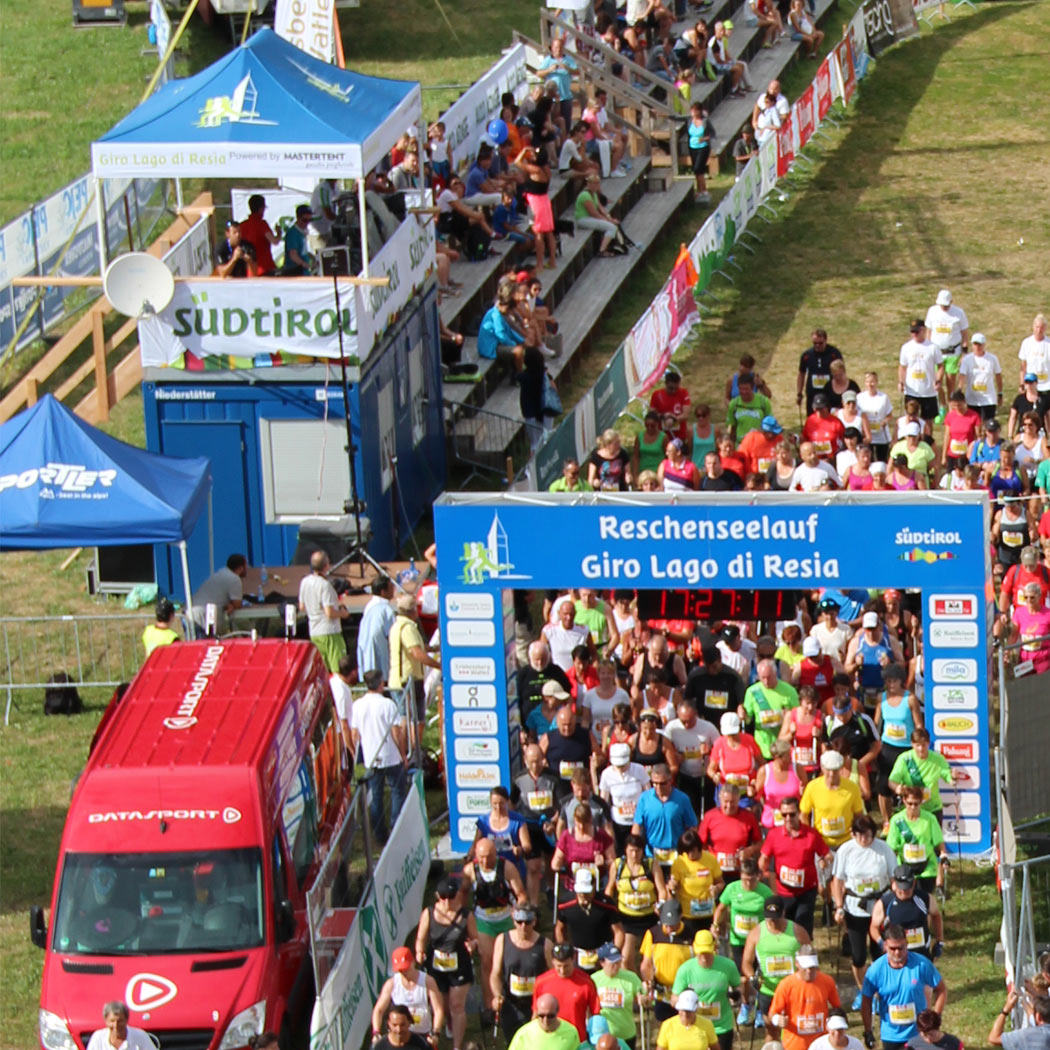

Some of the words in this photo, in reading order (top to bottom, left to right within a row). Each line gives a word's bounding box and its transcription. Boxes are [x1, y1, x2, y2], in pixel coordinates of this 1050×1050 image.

[99, 153, 128, 166] Giro
[133, 153, 167, 168] Lago
[172, 153, 185, 165] di
[190, 153, 226, 166] Resia
[284, 152, 346, 161] MASTERTENT
[155, 389, 216, 399] Niederstätter
[599, 513, 818, 543] Reschenseelauf
[581, 554, 641, 579] Giro
[651, 554, 709, 584] Lago
[727, 552, 753, 579] di
[764, 553, 840, 579] Resia
[946, 664, 966, 674] mila
[89, 810, 219, 823] DATASPORT
